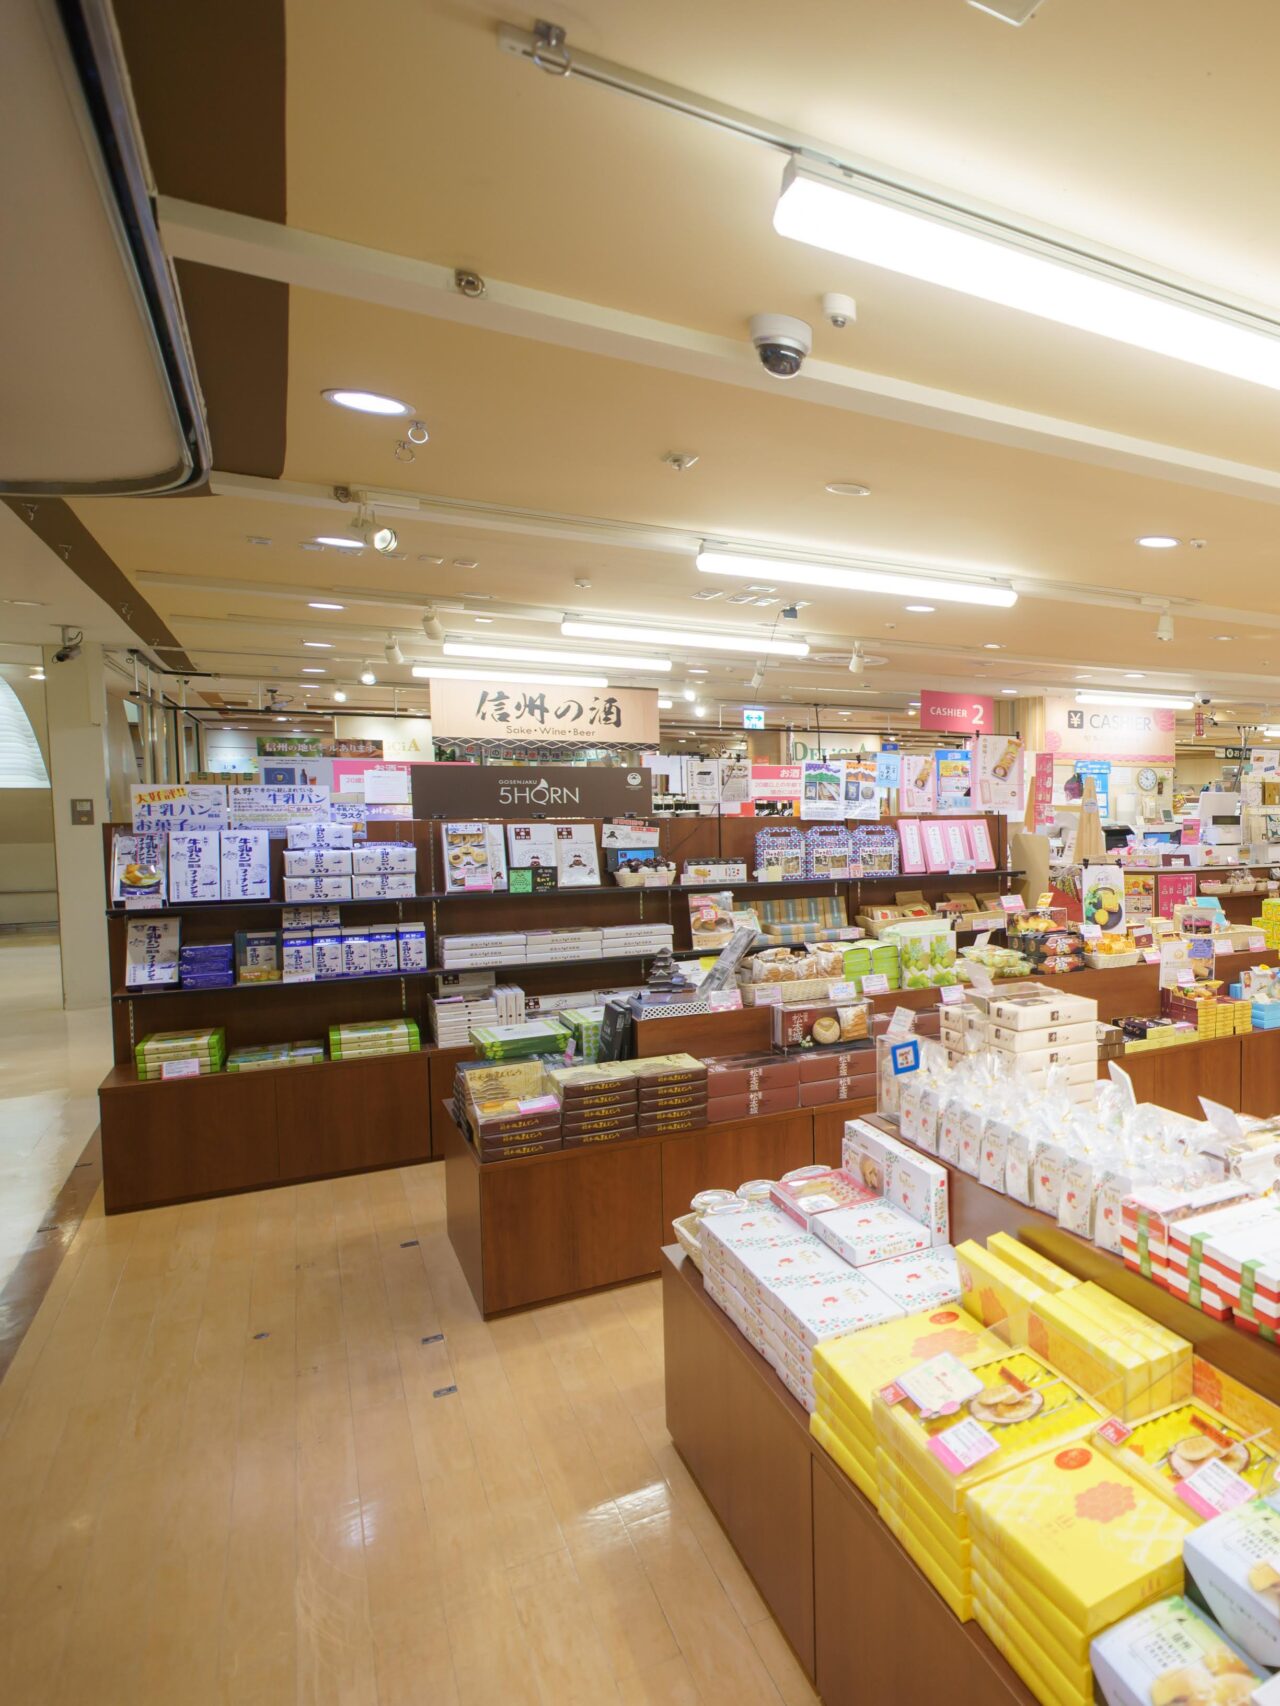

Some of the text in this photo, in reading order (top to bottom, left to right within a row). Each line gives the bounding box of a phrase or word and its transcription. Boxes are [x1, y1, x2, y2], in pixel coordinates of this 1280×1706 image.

[475, 690, 623, 727] 信州の酒
[930, 705, 985, 725] CASHIER 2
[1089, 713, 1152, 731] CASHIER
[265, 742, 376, 753] 信州の地ビールあります
[268, 793, 326, 804] 牛乳パン
[141, 803, 212, 817] 牛乳パン
